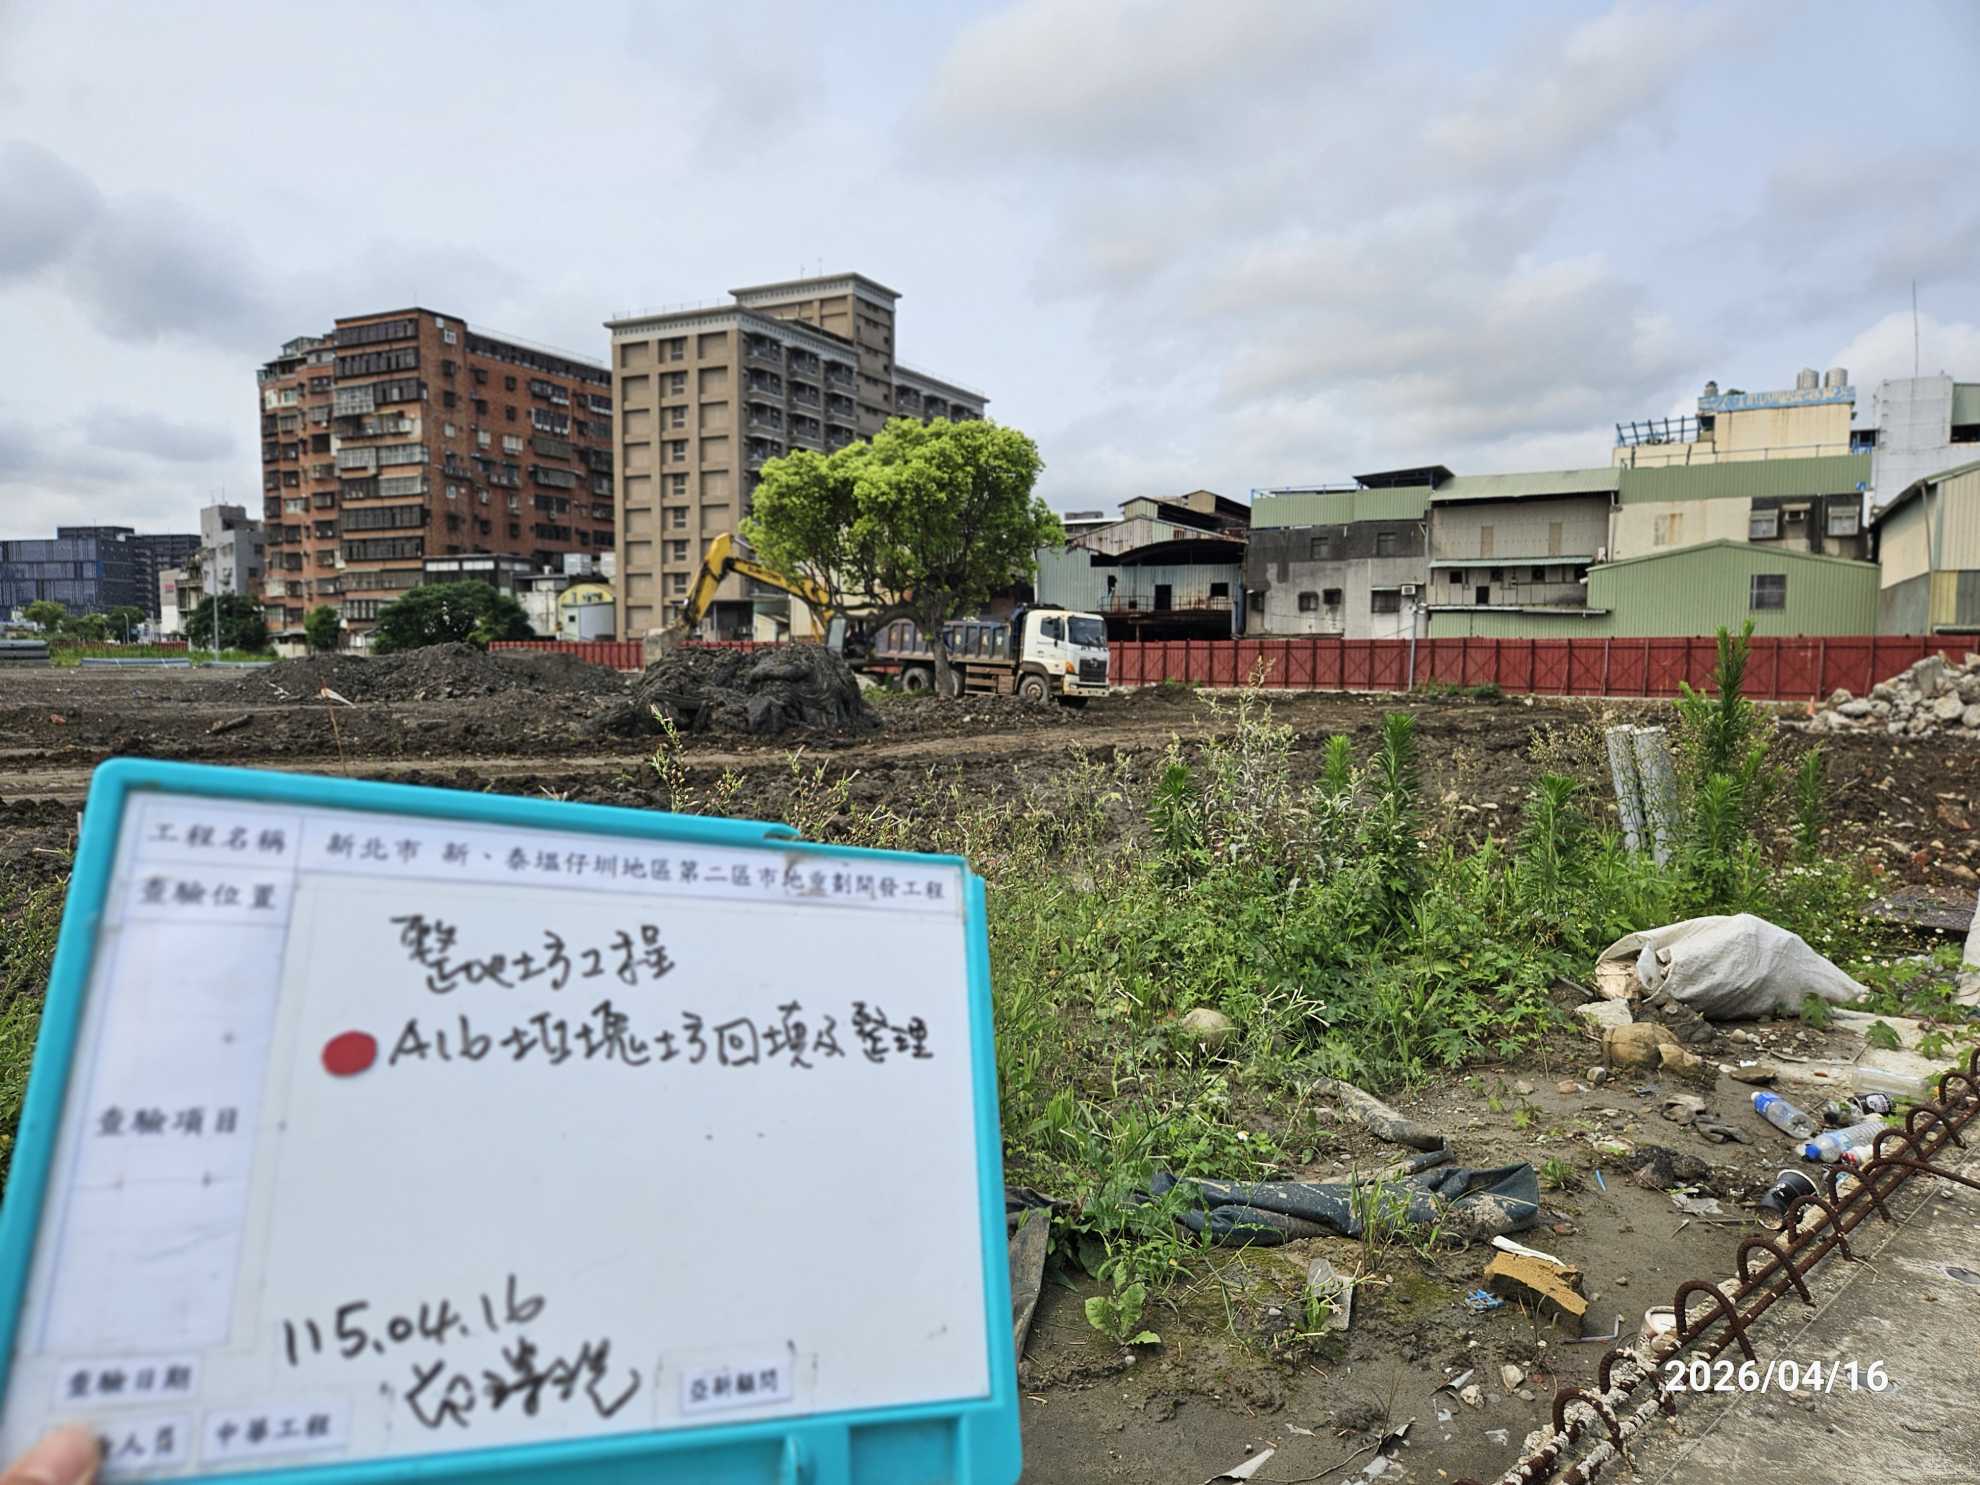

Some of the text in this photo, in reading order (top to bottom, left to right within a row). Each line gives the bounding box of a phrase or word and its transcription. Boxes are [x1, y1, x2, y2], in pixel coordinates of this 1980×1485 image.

[147, 824, 286, 854] 工程名稱
[326, 833, 421, 863] 新北市
[141, 876, 276, 909] 查驗位置
[97, 1106, 239, 1137] 查驗項目
[66, 1365, 192, 1399] 查驗日期
[215, 1413, 331, 1446] 中華工程
